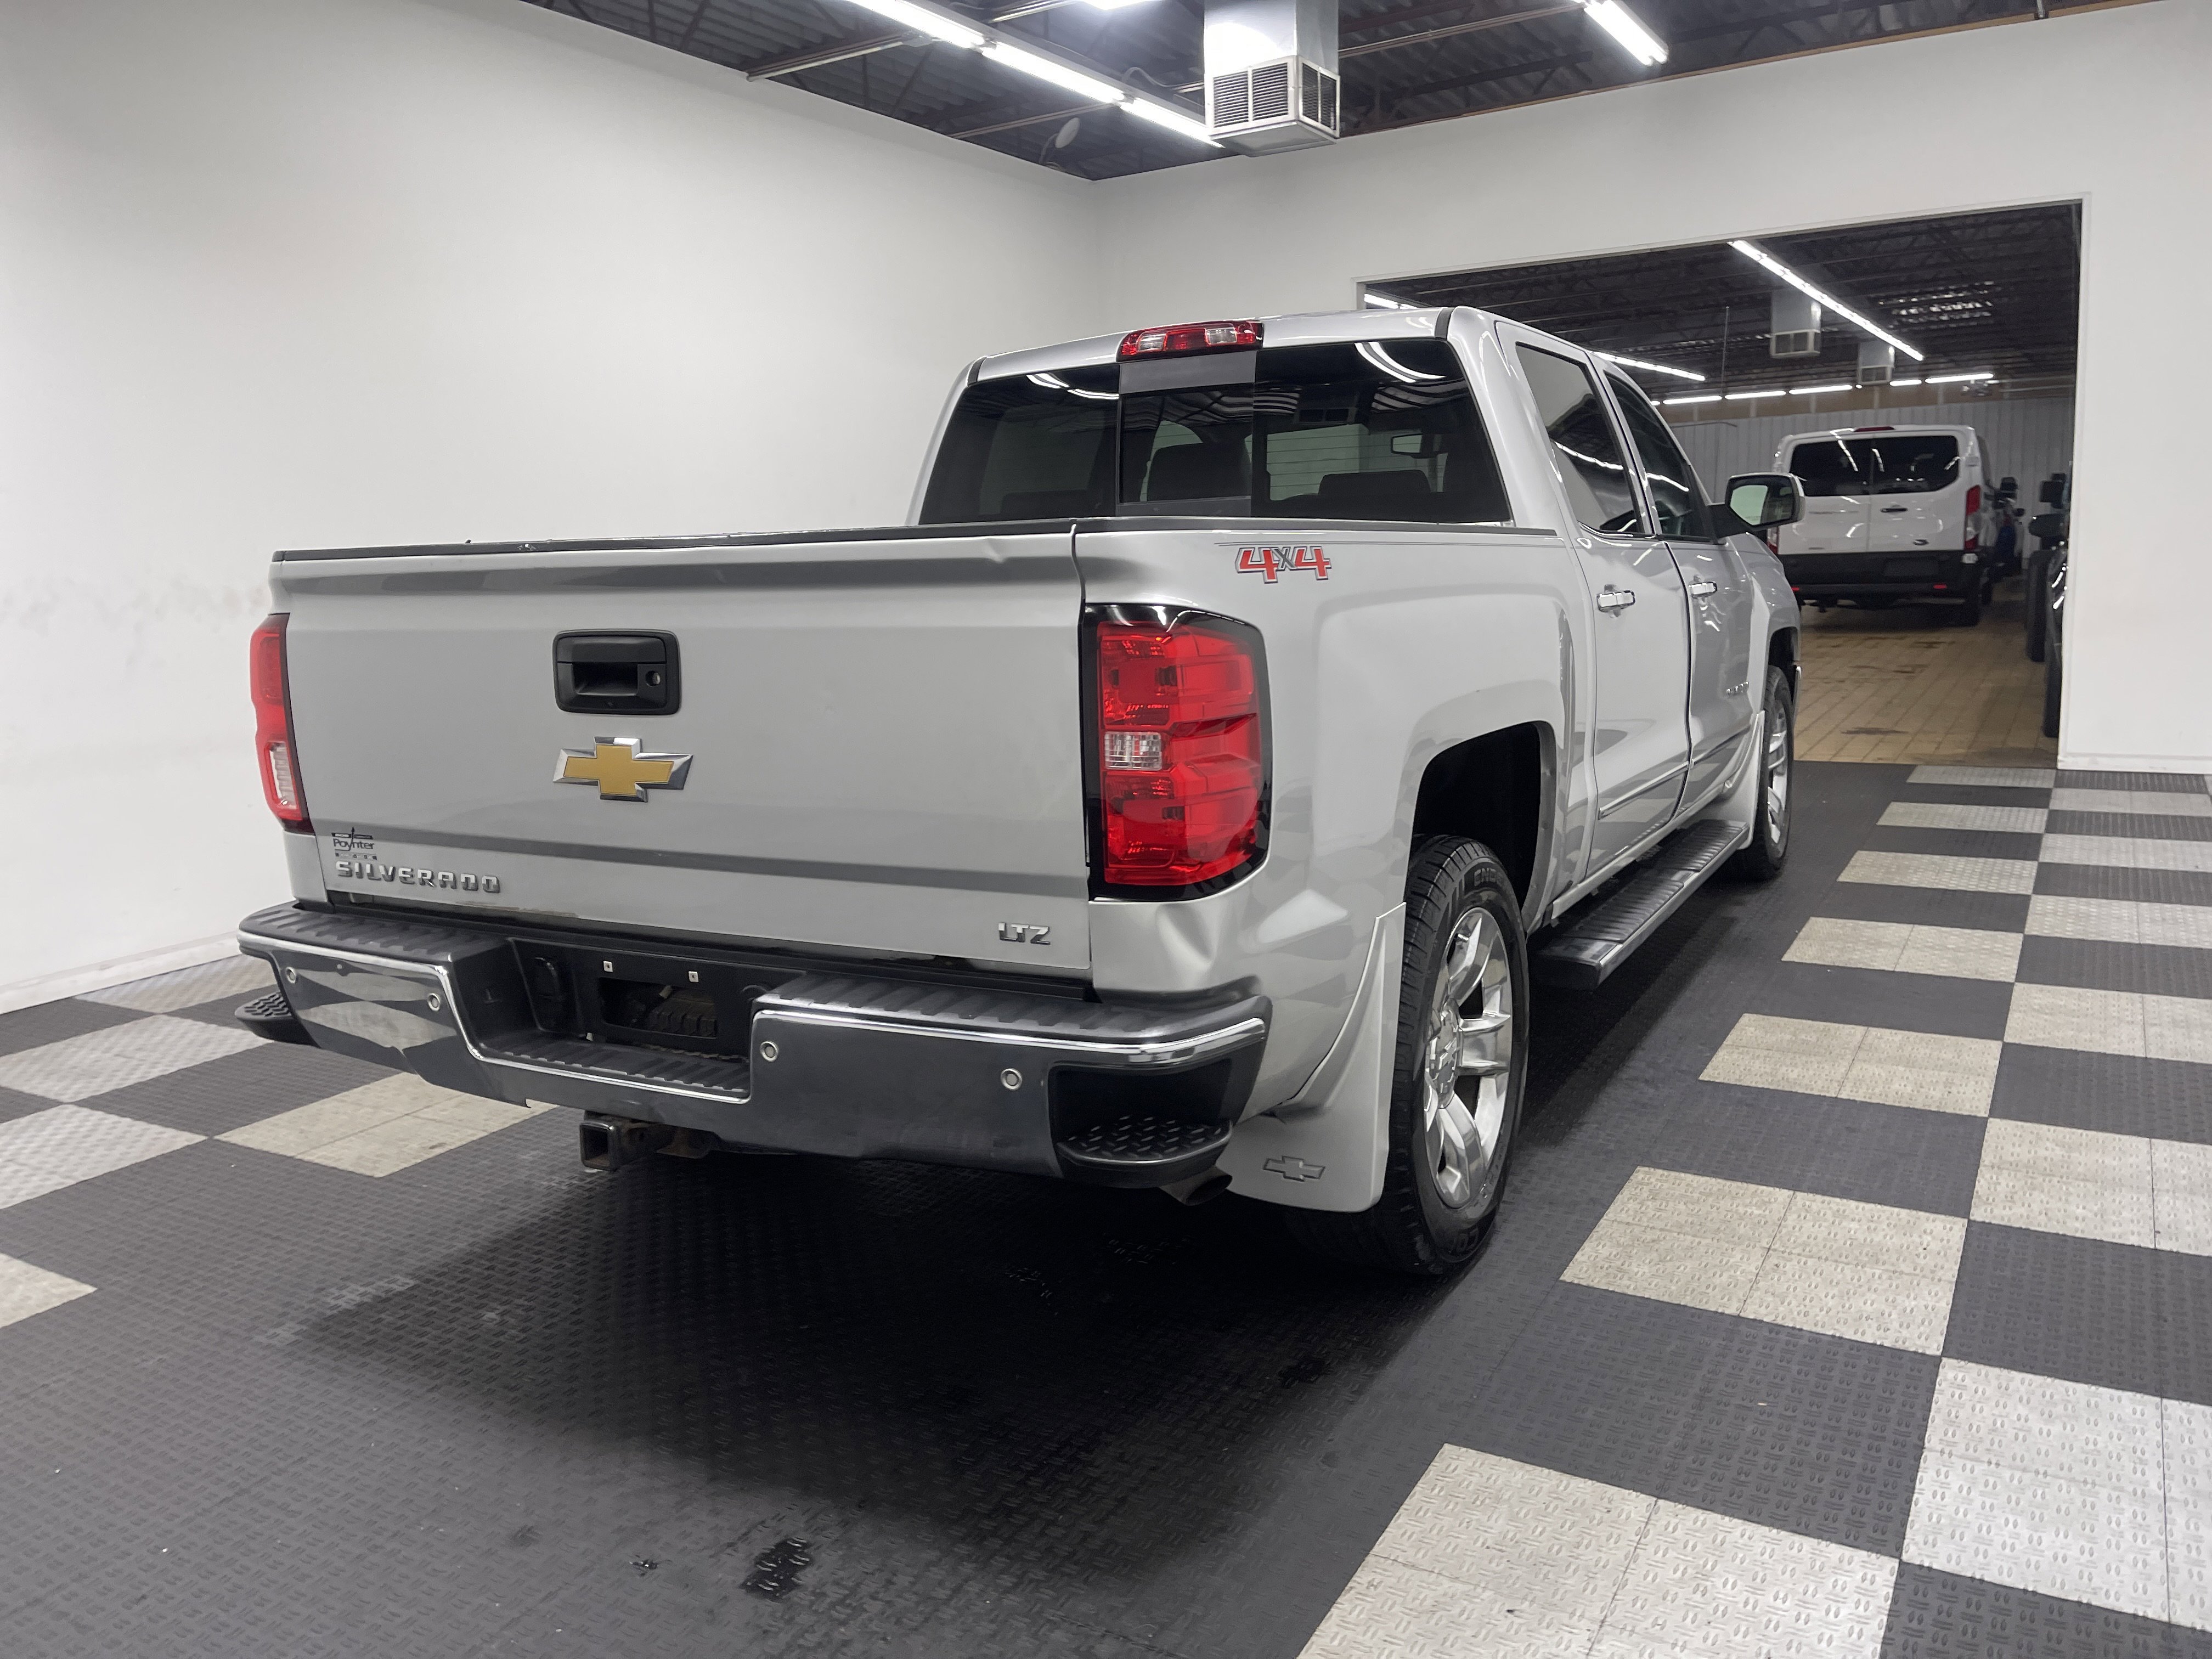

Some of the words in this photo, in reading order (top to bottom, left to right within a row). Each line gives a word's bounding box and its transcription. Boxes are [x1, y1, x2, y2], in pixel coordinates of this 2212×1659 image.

[333, 838, 374, 851] Poynter
[335, 860, 500, 893] SILVERADO
[998, 922, 1051, 945] LTZ
